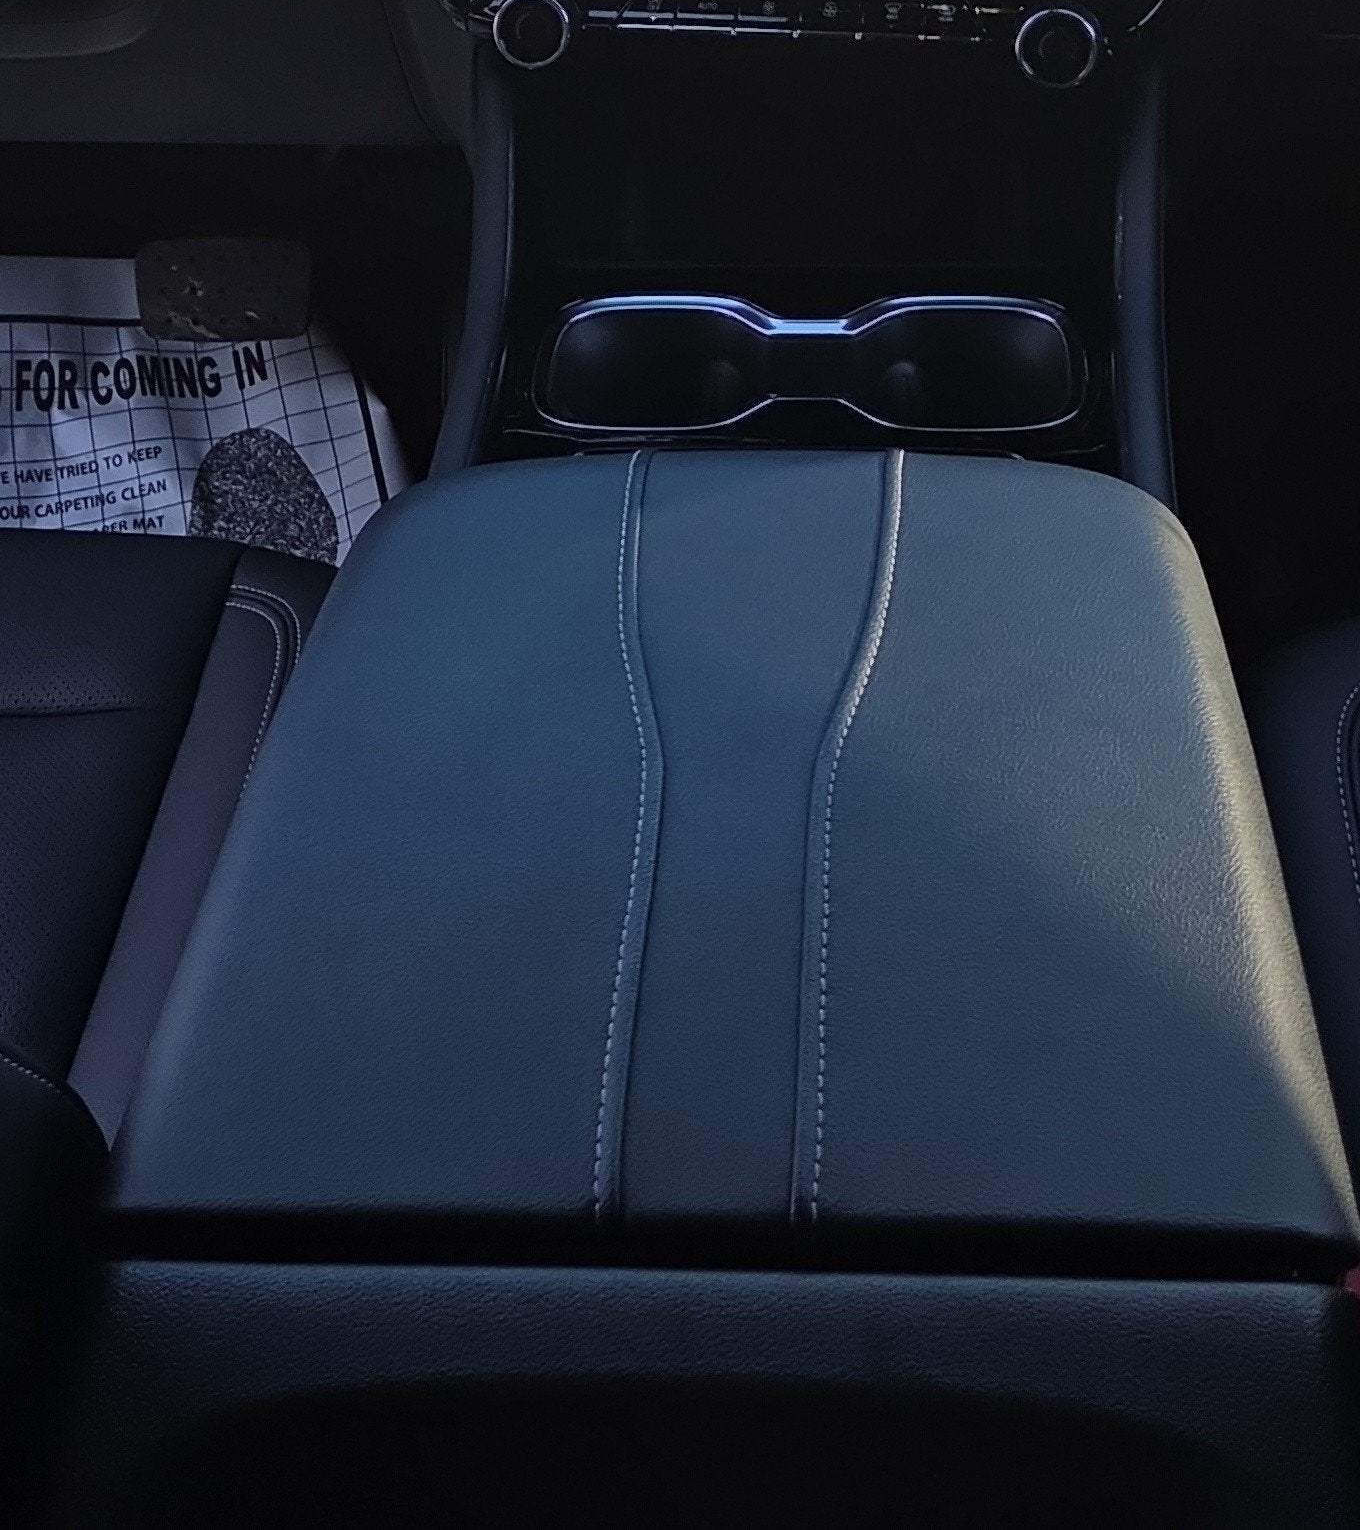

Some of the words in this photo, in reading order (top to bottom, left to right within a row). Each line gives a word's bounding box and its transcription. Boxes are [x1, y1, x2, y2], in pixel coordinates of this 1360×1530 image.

[14, 356, 80, 411] FOR
[89, 355, 222, 406] COMING
[232, 340, 269, 392] IN
[14, 467, 54, 485] HAVE
[58, 459, 100, 480] TRIED
[103, 452, 124, 469] TO
[127, 445, 163, 465] KEEP
[34, 490, 117, 519] CARPETING
[120, 478, 168, 501] CLEAN
[133, 514, 165, 531] MAT
